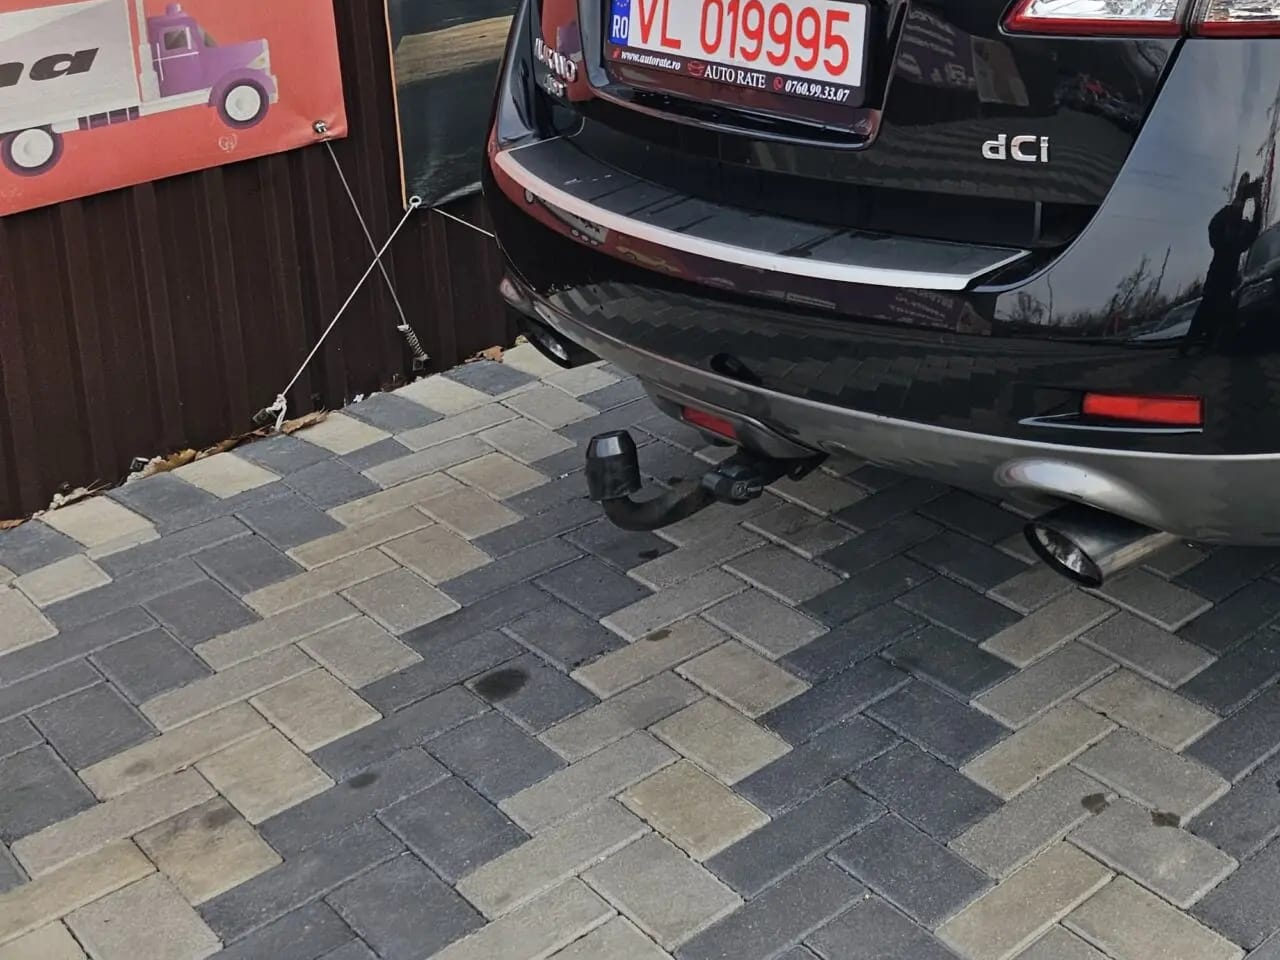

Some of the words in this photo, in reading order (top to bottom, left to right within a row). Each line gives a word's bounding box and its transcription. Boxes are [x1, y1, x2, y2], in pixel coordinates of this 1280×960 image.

[612, 14, 629, 39] RO
[620, 51, 681, 71] www.autorate.ro
[704, 65, 735, 84] AUTO
[737, 71, 766, 89] RATE
[785, 81, 850, 103] 0760.99.33.07
[982, 134, 1049, 163] dCi
